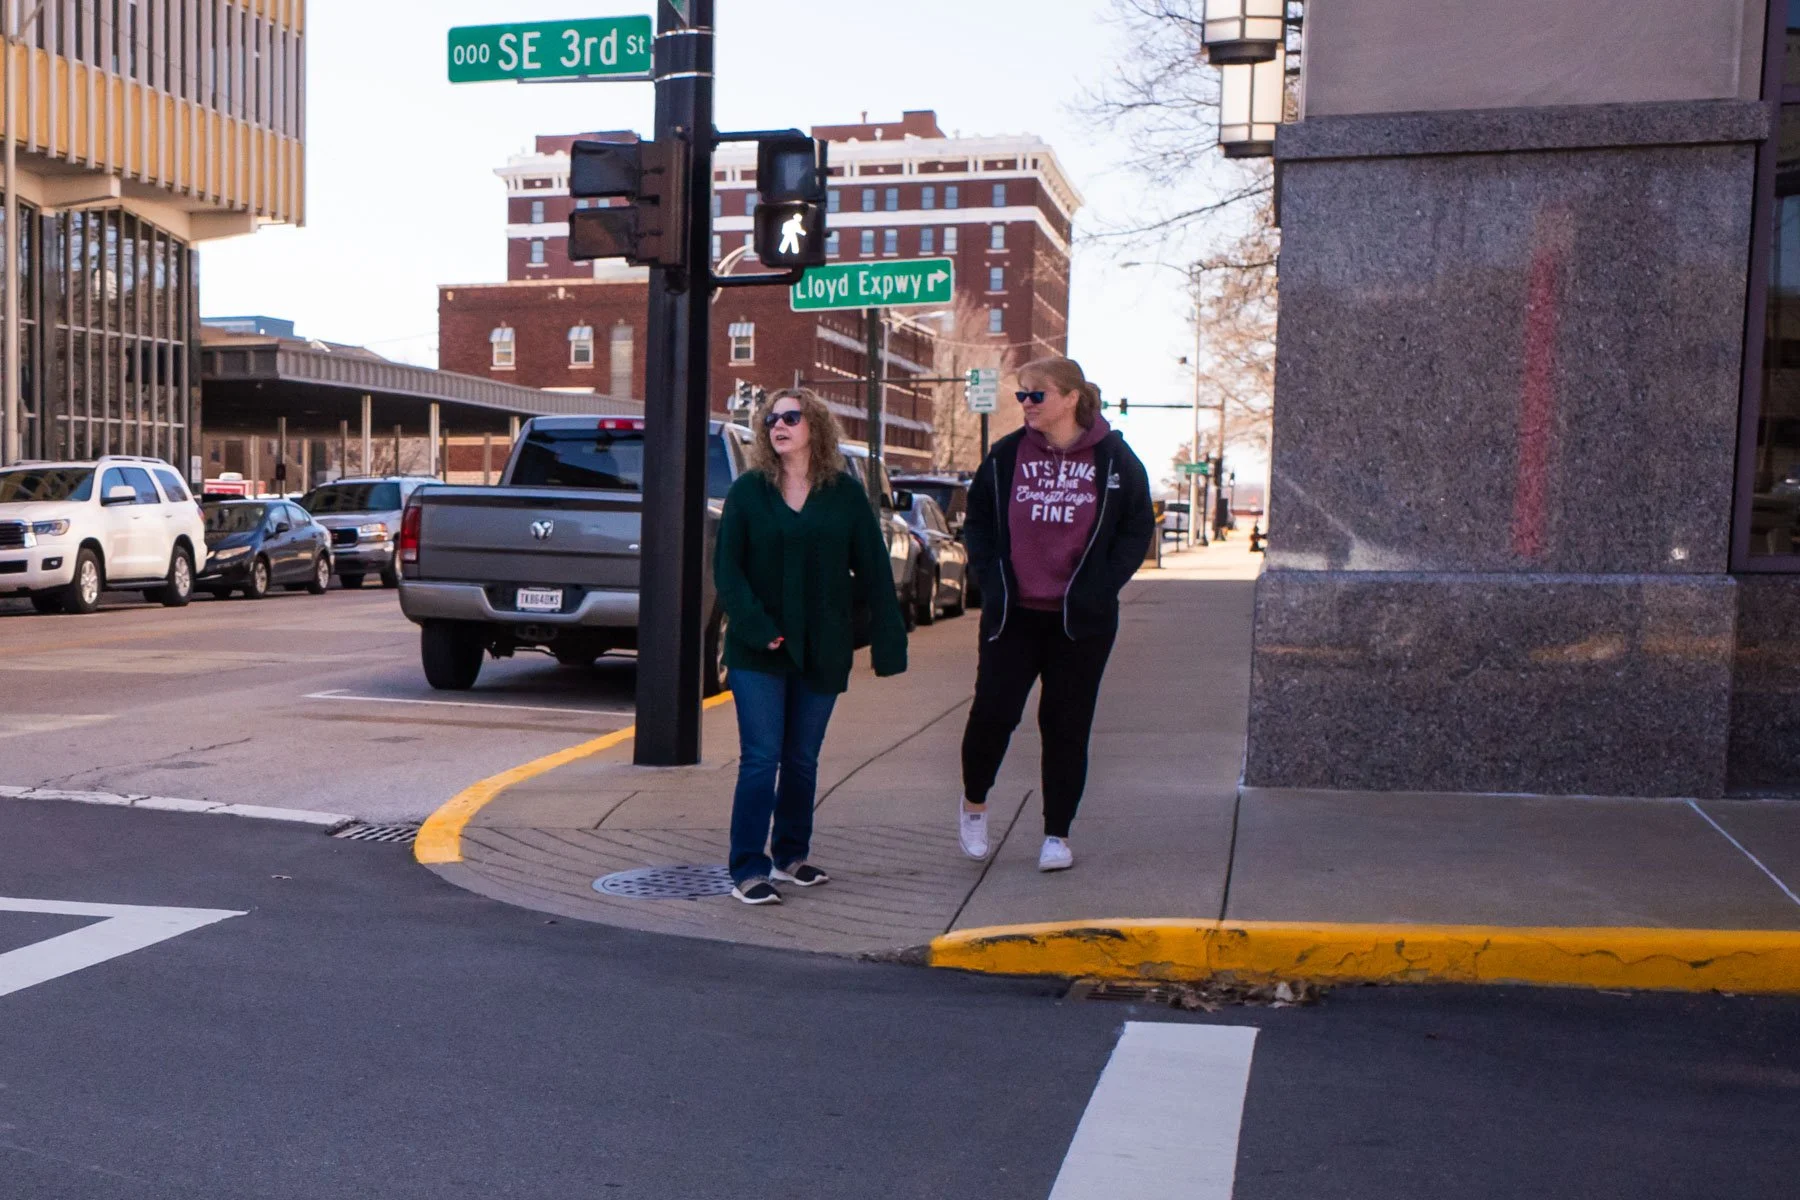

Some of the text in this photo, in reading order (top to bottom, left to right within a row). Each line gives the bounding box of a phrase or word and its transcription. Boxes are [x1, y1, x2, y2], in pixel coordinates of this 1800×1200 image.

[453, 27, 646, 72] 000 SE 3rd St
[796, 270, 923, 303] Lloyd Expwy
[1021, 460, 1054, 479] IT'S
[1060, 460, 1097, 482] FINE
[1037, 478, 1055, 489] I'M
[1030, 503, 1076, 523] FINE
